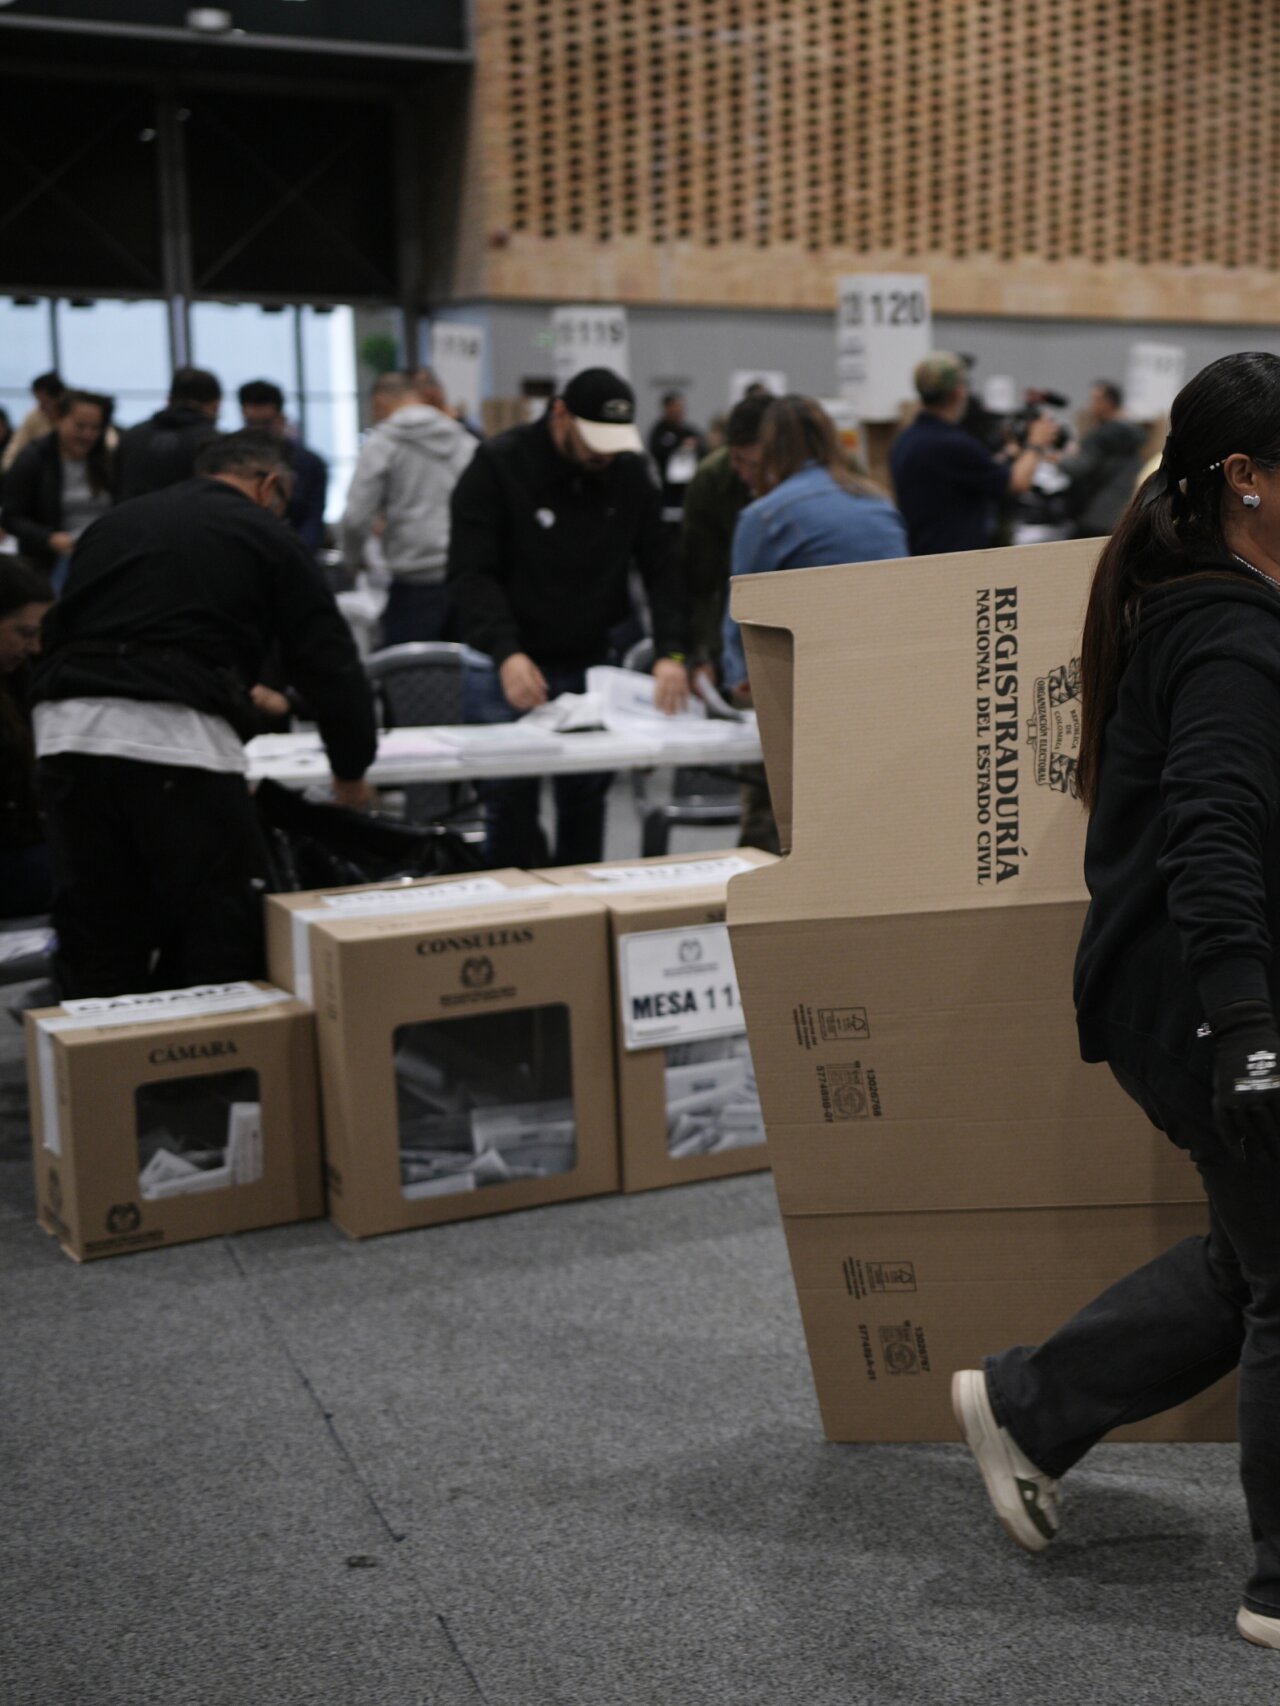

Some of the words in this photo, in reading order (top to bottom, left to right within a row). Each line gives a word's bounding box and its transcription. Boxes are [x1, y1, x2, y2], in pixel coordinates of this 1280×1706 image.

[871, 290, 925, 327] 120
[976, 589, 991, 690] NACIONAL
[976, 697, 991, 737] DEL
[1036, 680, 1049, 738] ORGANIZACIÓN
[995, 585, 1028, 885] REGISTRADURÍA
[1053, 711, 1063, 750] COLOMBIA
[1037, 739, 1048, 783] ELECTORAL
[976, 744, 991, 825] ESTADO
[976, 831, 991, 885] CIVIL
[416, 927, 534, 957] CONSULTAS
[632, 988, 698, 1020] MESA
[704, 982, 743, 1010] 11
[148, 1039, 239, 1064] CÁMARA
